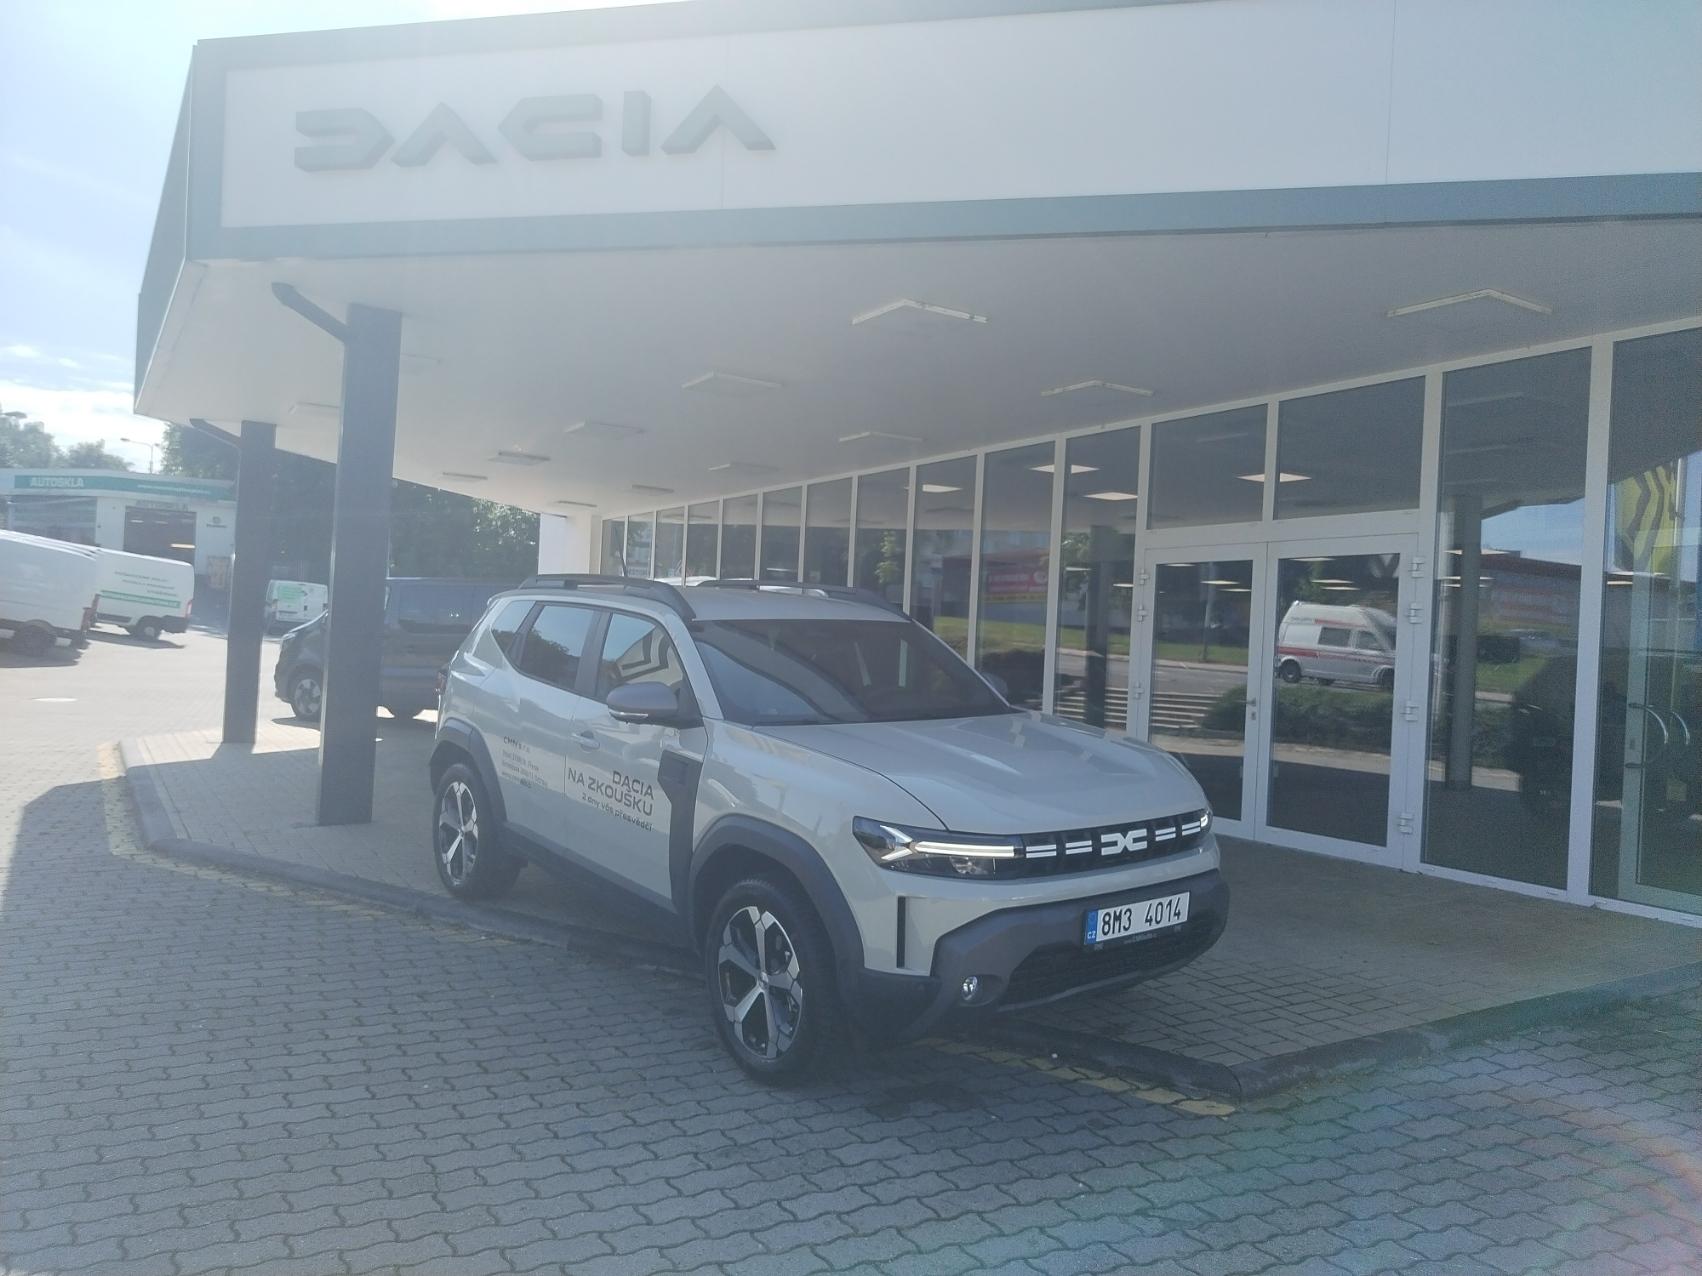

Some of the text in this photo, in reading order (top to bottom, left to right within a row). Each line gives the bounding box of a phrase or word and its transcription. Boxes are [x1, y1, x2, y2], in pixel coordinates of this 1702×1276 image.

[294, 83, 777, 172] DACIA
[30, 477, 84, 488] AUTOSKLA
[568, 767, 585, 786] NA
[587, 776, 653, 816] ZKOUŠKU
[612, 770, 654, 800] DACIA
[1087, 930, 1096, 940] CZ
[1101, 907, 1133, 936] 8M3
[1144, 897, 1182, 927] 4014
